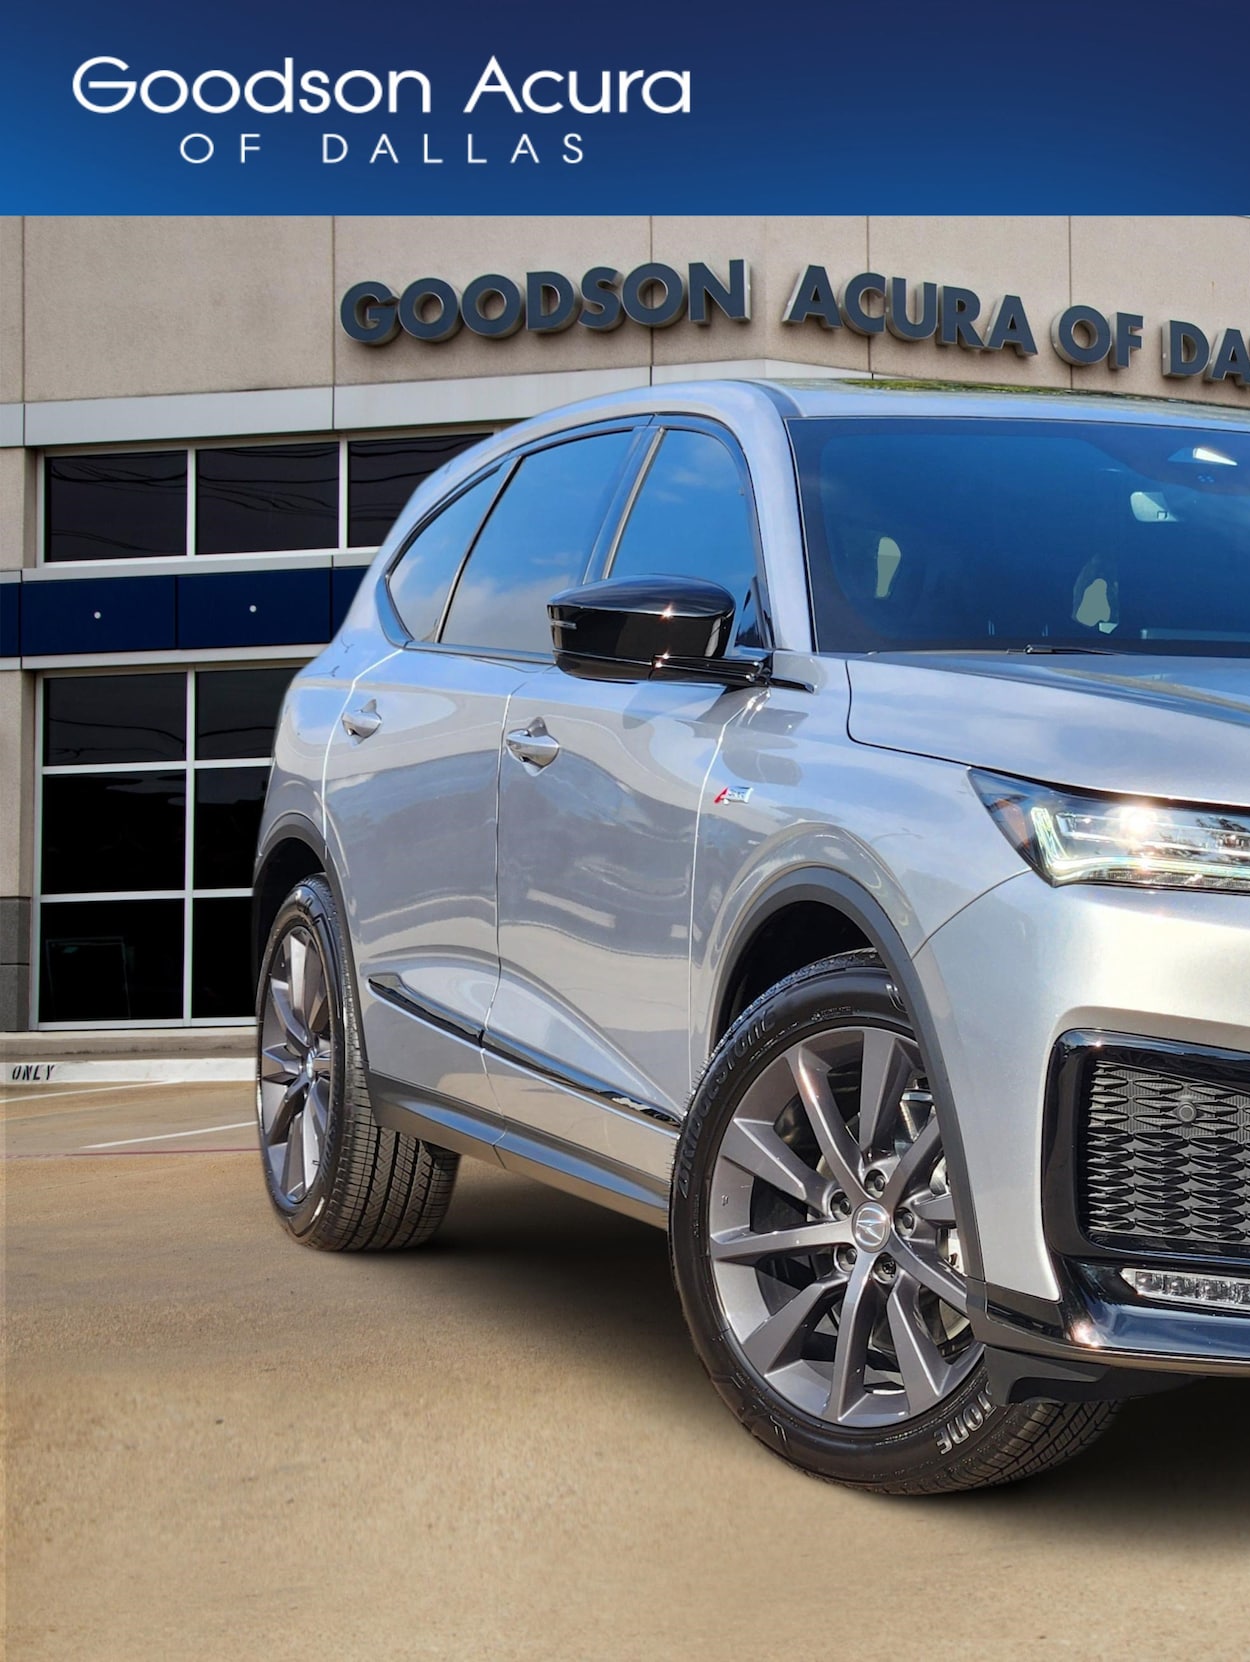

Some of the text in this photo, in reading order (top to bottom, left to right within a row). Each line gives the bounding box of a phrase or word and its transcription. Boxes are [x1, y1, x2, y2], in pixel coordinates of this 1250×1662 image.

[340, 258, 751, 350] GOODSON
[782, 264, 1038, 357] ACURA
[1050, 304, 1144, 369] OF
[12, 1064, 56, 1081] ONLY
